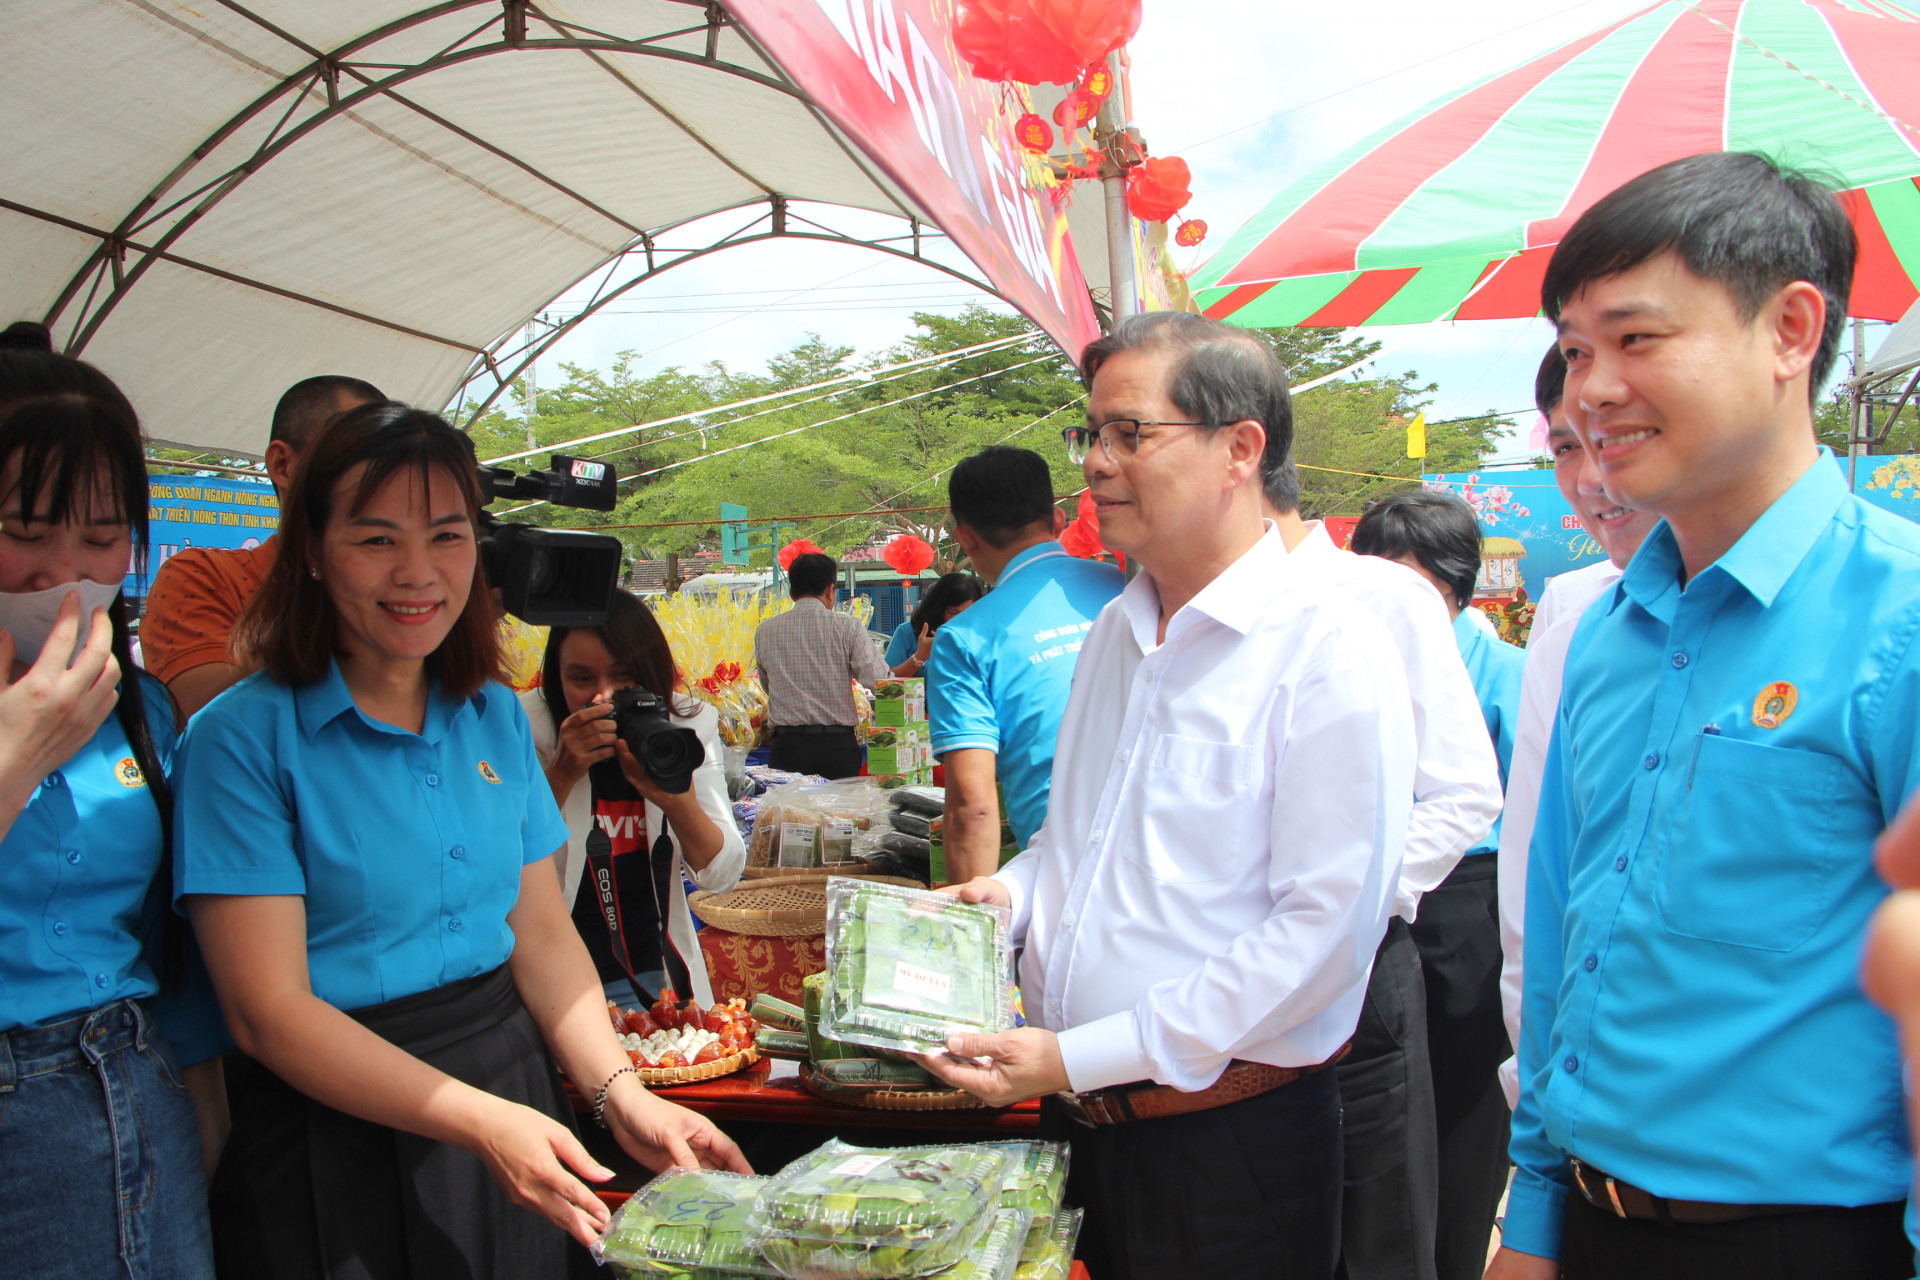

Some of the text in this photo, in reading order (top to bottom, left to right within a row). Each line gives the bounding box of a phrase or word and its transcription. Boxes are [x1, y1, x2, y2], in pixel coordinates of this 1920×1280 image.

[980, 132, 1066, 316] GIÁ
[574, 462, 603, 479] KTV
[204, 485, 234, 504] NGÀNH
[234, 489, 258, 506] NÔNG
[193, 507, 217, 525] NÔNG
[218, 510, 240, 527] THÔN
[598, 868, 617, 931] EOS 80D
